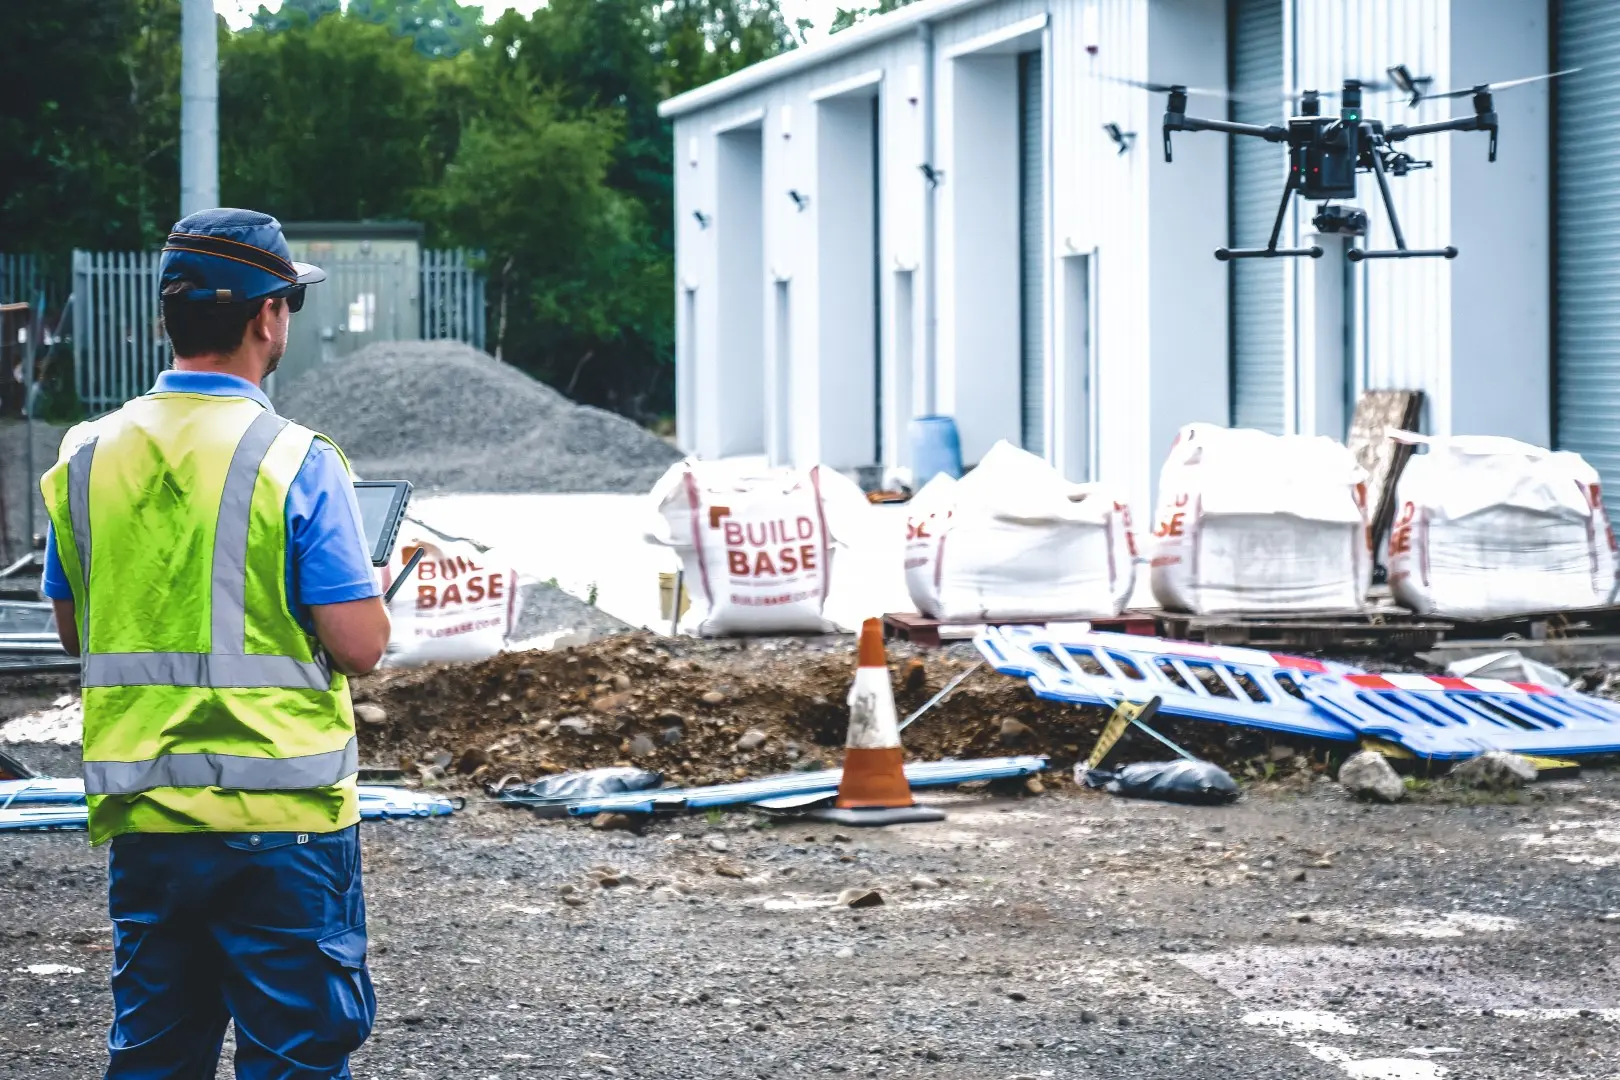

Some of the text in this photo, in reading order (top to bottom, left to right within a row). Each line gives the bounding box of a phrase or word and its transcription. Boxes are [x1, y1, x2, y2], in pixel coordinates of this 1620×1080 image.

[724, 517, 814, 547] BUILD
[418, 556, 484, 580] BUIL
[728, 545, 816, 576] BASE
[416, 573, 503, 609] BASE
